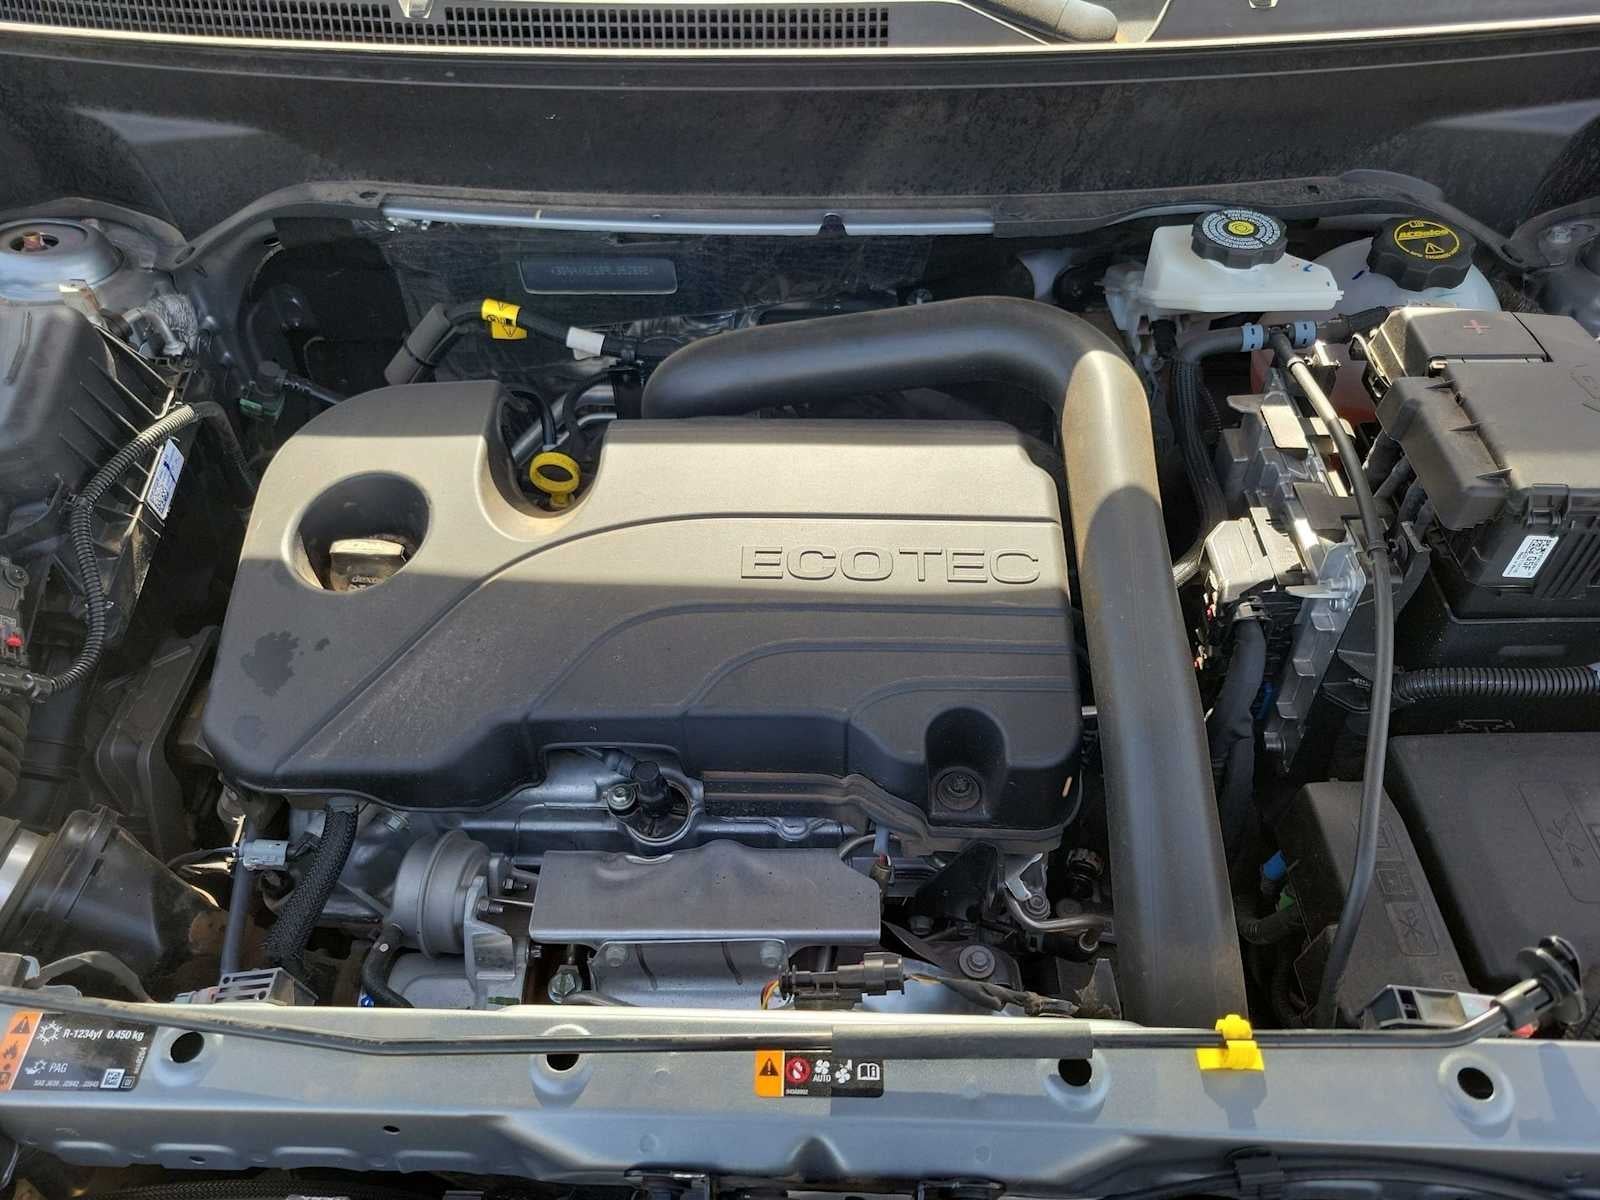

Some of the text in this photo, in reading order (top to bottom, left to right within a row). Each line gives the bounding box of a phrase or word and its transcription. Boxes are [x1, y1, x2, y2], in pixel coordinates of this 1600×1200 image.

[740, 546, 1041, 585] ECOTEC
[106, 1030, 131, 1040] 0.450
[132, 1030, 145, 1042] kg
[48, 1063, 69, 1073] PAG
[812, 1074, 832, 1083] AUTO
